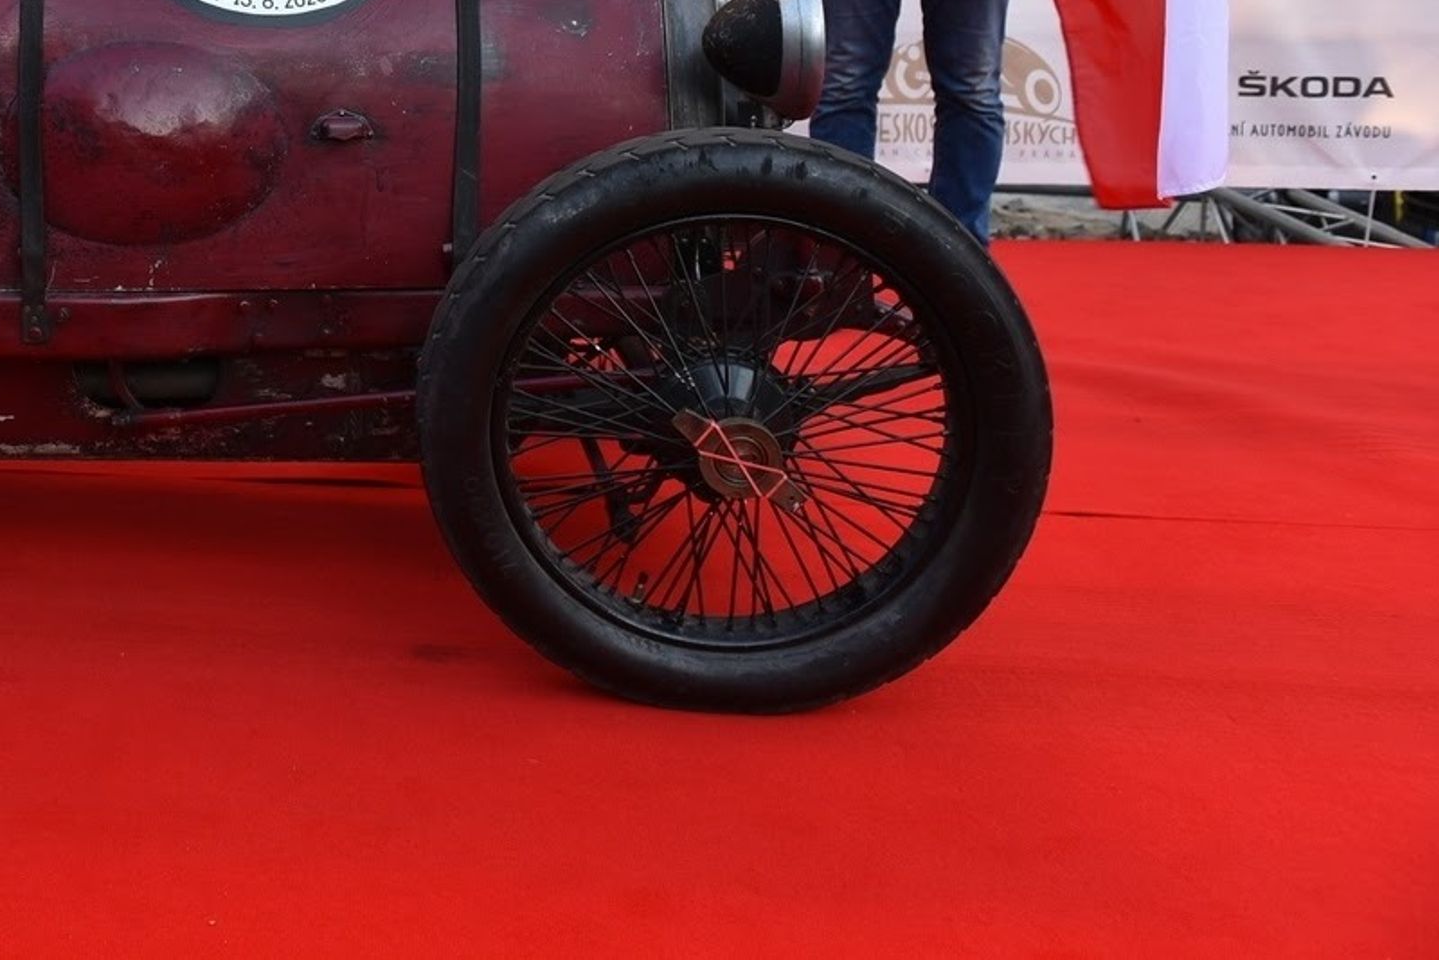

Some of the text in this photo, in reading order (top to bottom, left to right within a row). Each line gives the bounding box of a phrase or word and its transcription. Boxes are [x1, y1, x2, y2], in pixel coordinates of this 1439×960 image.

[1237, 70, 1395, 98] ŠKODA
[1250, 123, 1329, 139] AUTOMOBIL
[1336, 122, 1391, 139] ZÁVODU
